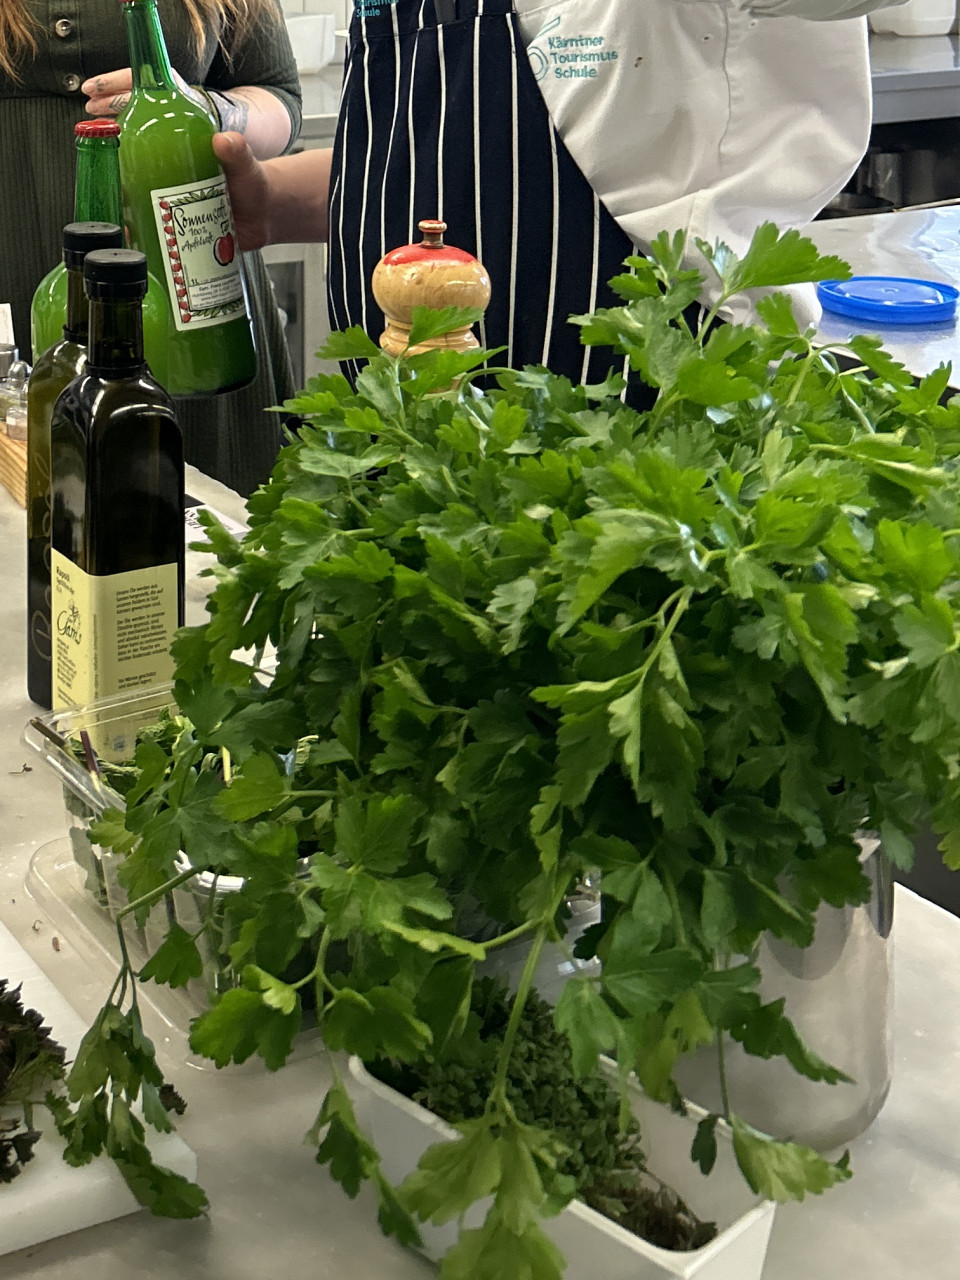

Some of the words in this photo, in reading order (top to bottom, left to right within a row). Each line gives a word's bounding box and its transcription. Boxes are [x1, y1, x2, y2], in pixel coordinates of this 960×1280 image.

[548, 35, 604, 49] Kärntner
[550, 51, 618, 64] Tourismus
[554, 66, 597, 78] Schule
